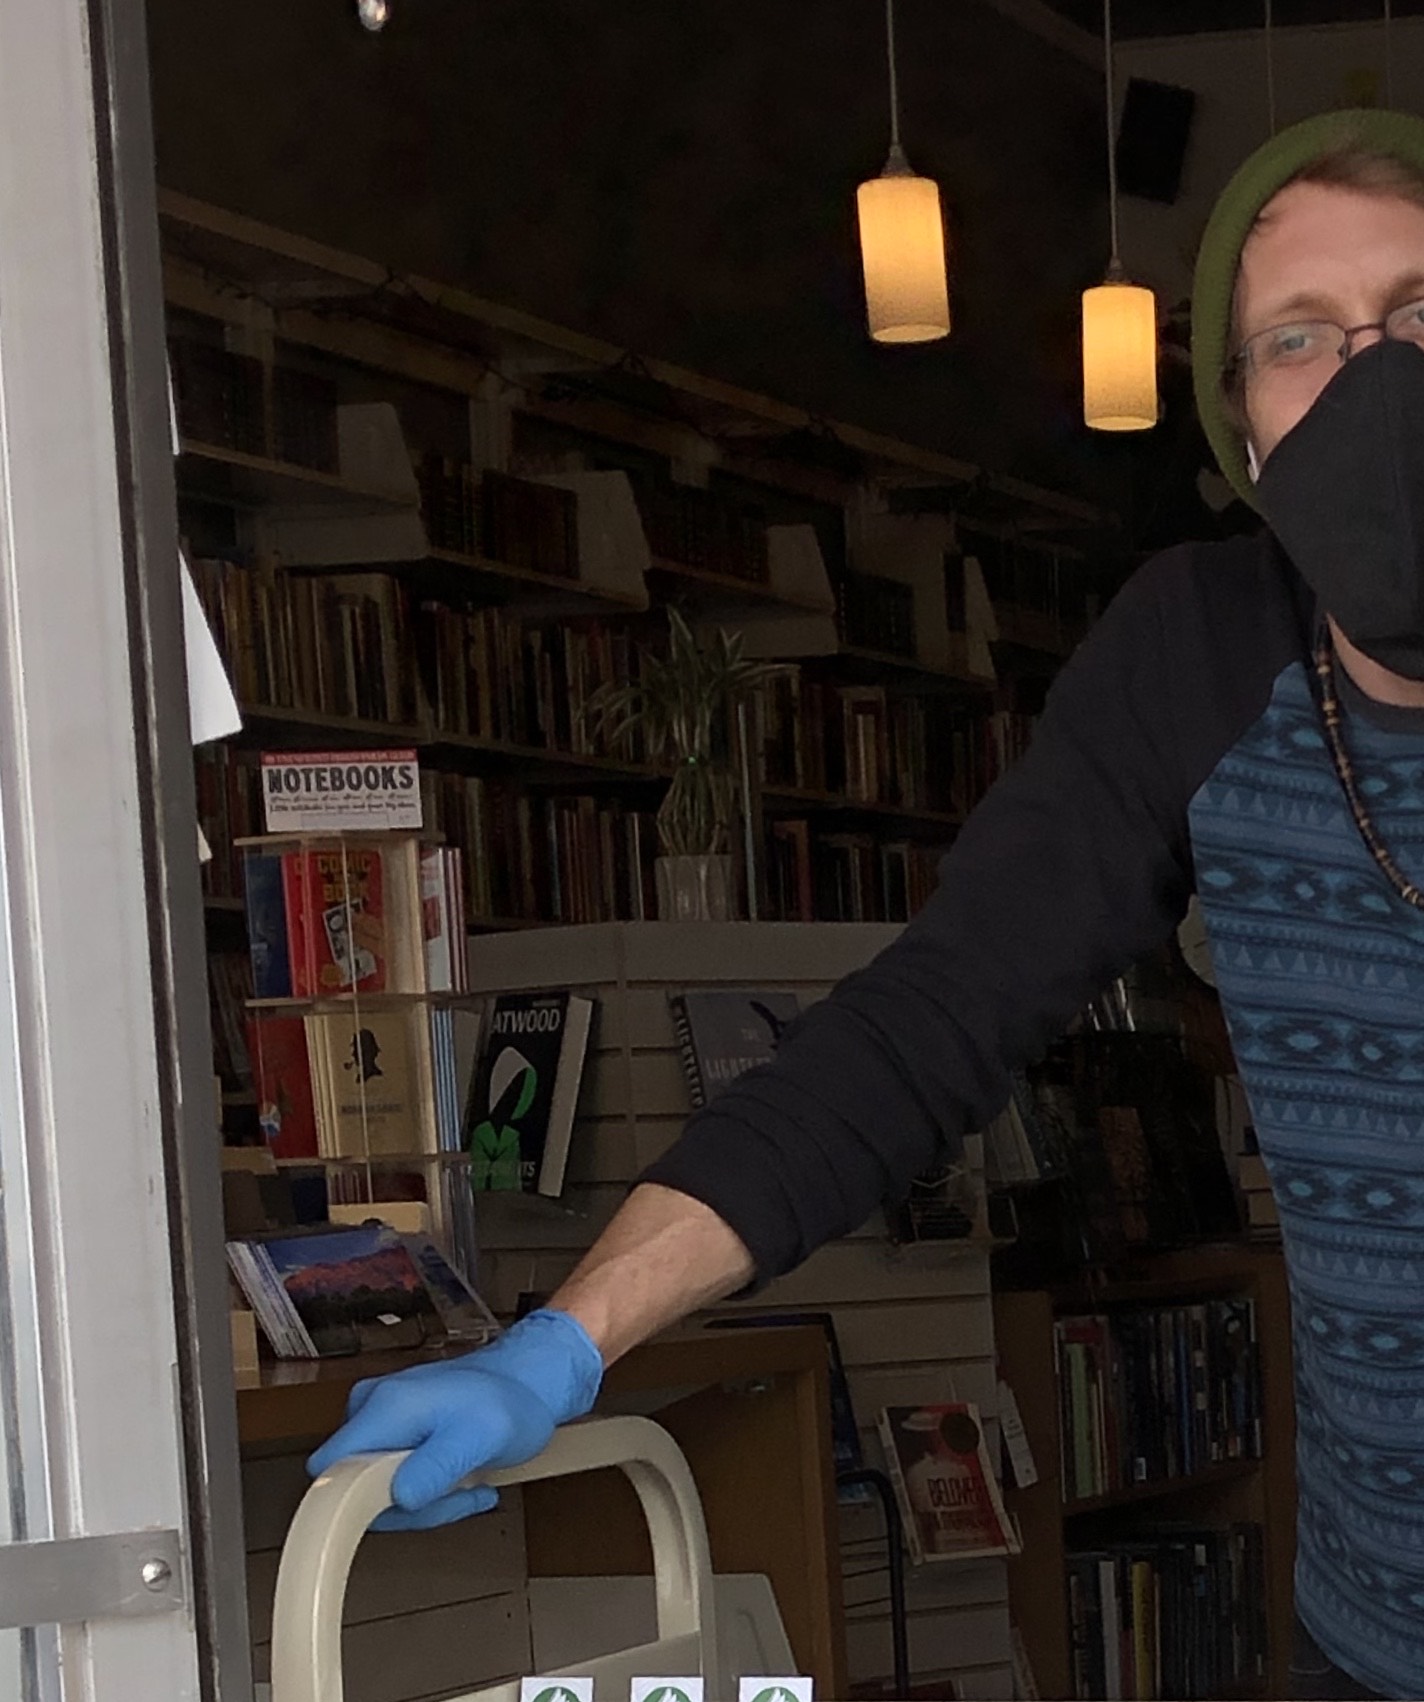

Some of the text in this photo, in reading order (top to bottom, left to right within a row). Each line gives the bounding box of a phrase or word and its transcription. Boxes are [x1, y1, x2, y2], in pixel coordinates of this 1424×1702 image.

[268, 765, 413, 793] NOTEBOOKS
[318, 855, 370, 872] COMIC
[492, 1009, 560, 1033] ATWOOD
